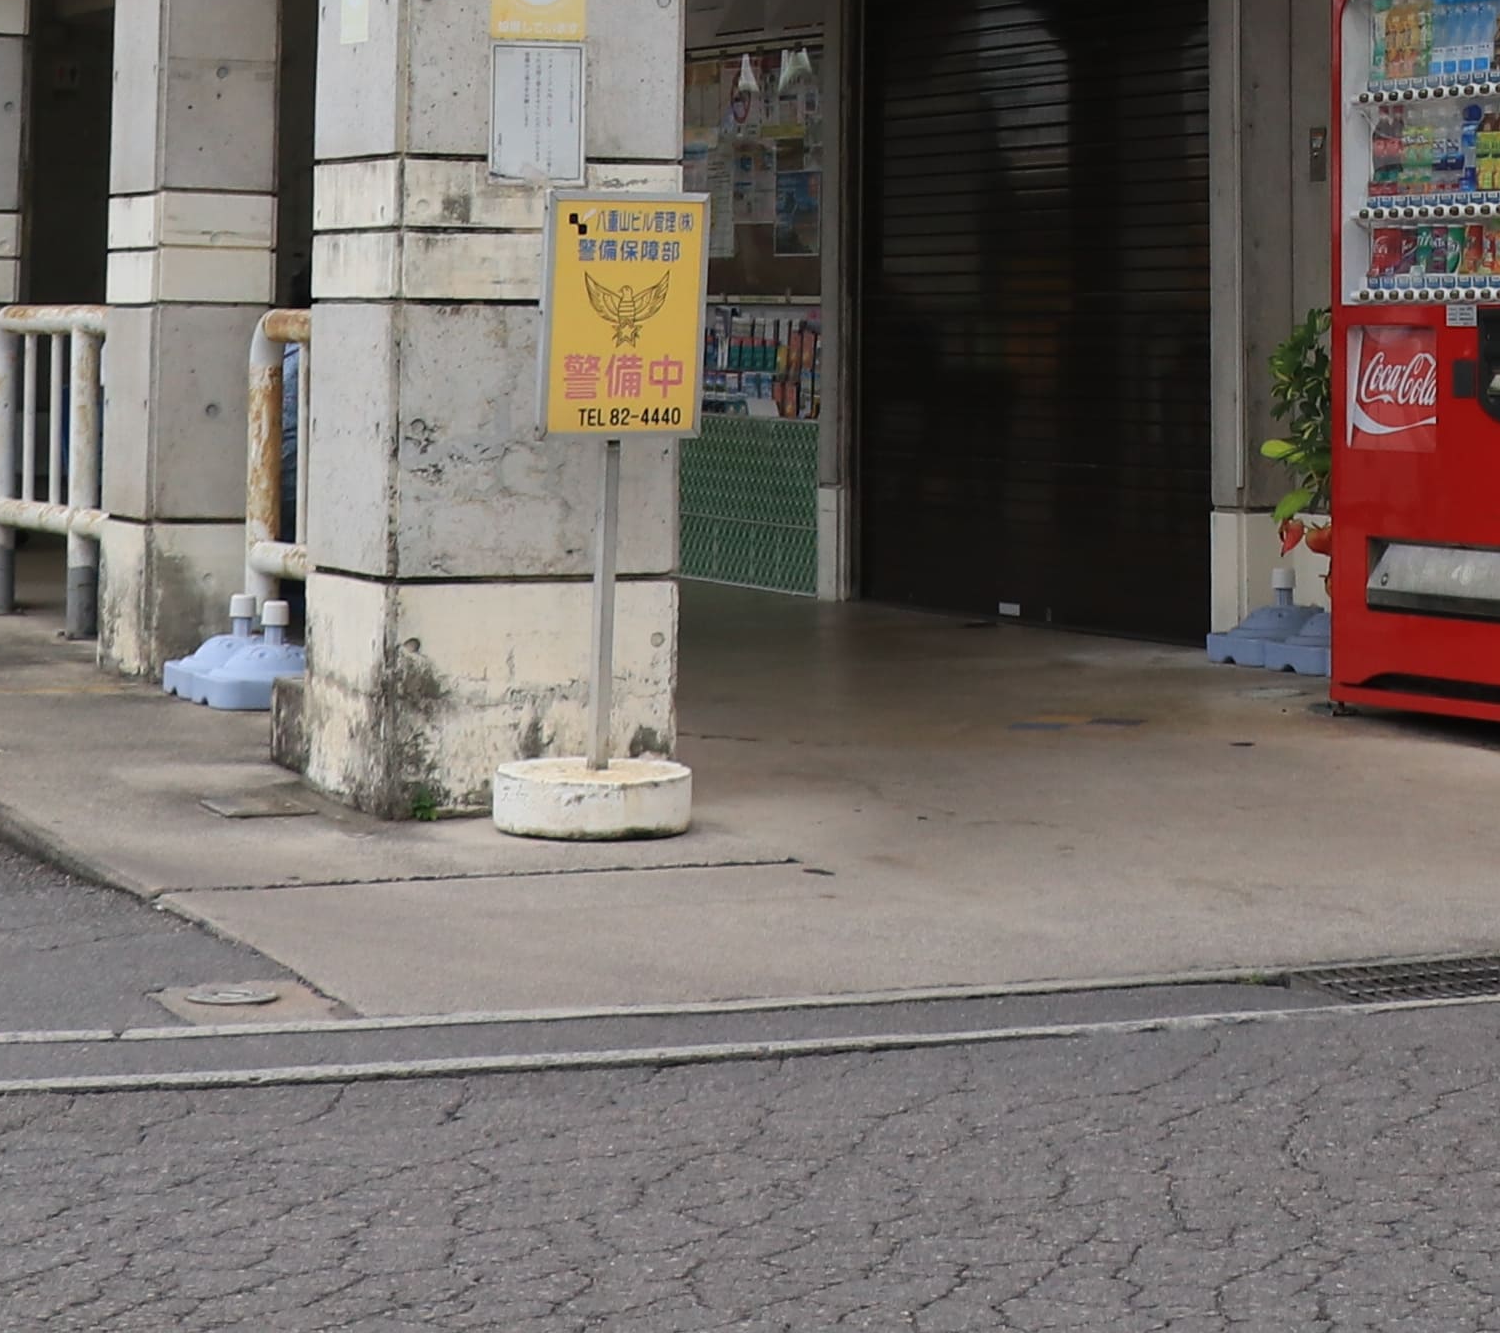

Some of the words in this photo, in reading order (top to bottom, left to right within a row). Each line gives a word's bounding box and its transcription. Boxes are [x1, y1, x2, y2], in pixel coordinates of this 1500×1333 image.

[578, 239, 681, 262] 警備保障部
[563, 353, 684, 400] 警備中
[579, 408, 606, 427] TEL
[609, 407, 682, 426] 82-4440
